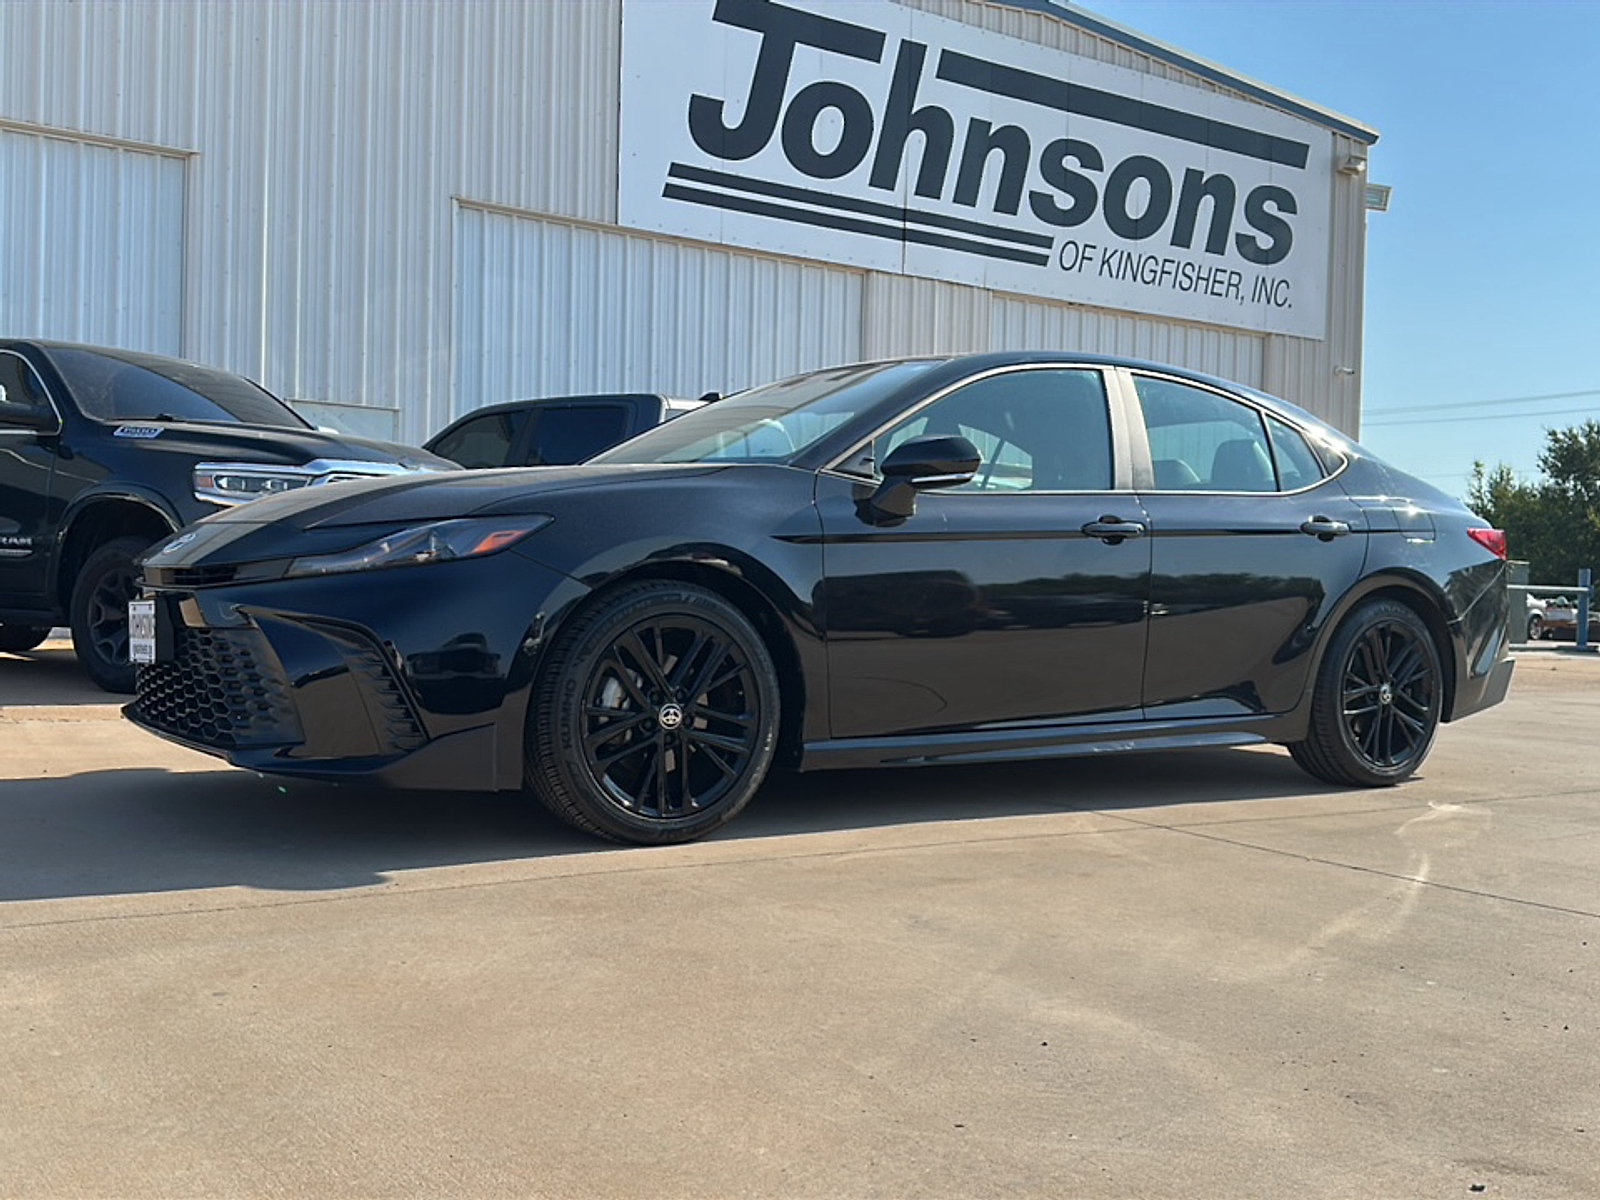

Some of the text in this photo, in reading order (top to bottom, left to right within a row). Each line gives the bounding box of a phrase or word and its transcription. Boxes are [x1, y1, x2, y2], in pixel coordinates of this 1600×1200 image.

[687, 0, 1298, 266] Johnsons
[1059, 240, 1293, 308] OF KINGFISHER, INC.
[560, 678, 577, 749] KUMHO
